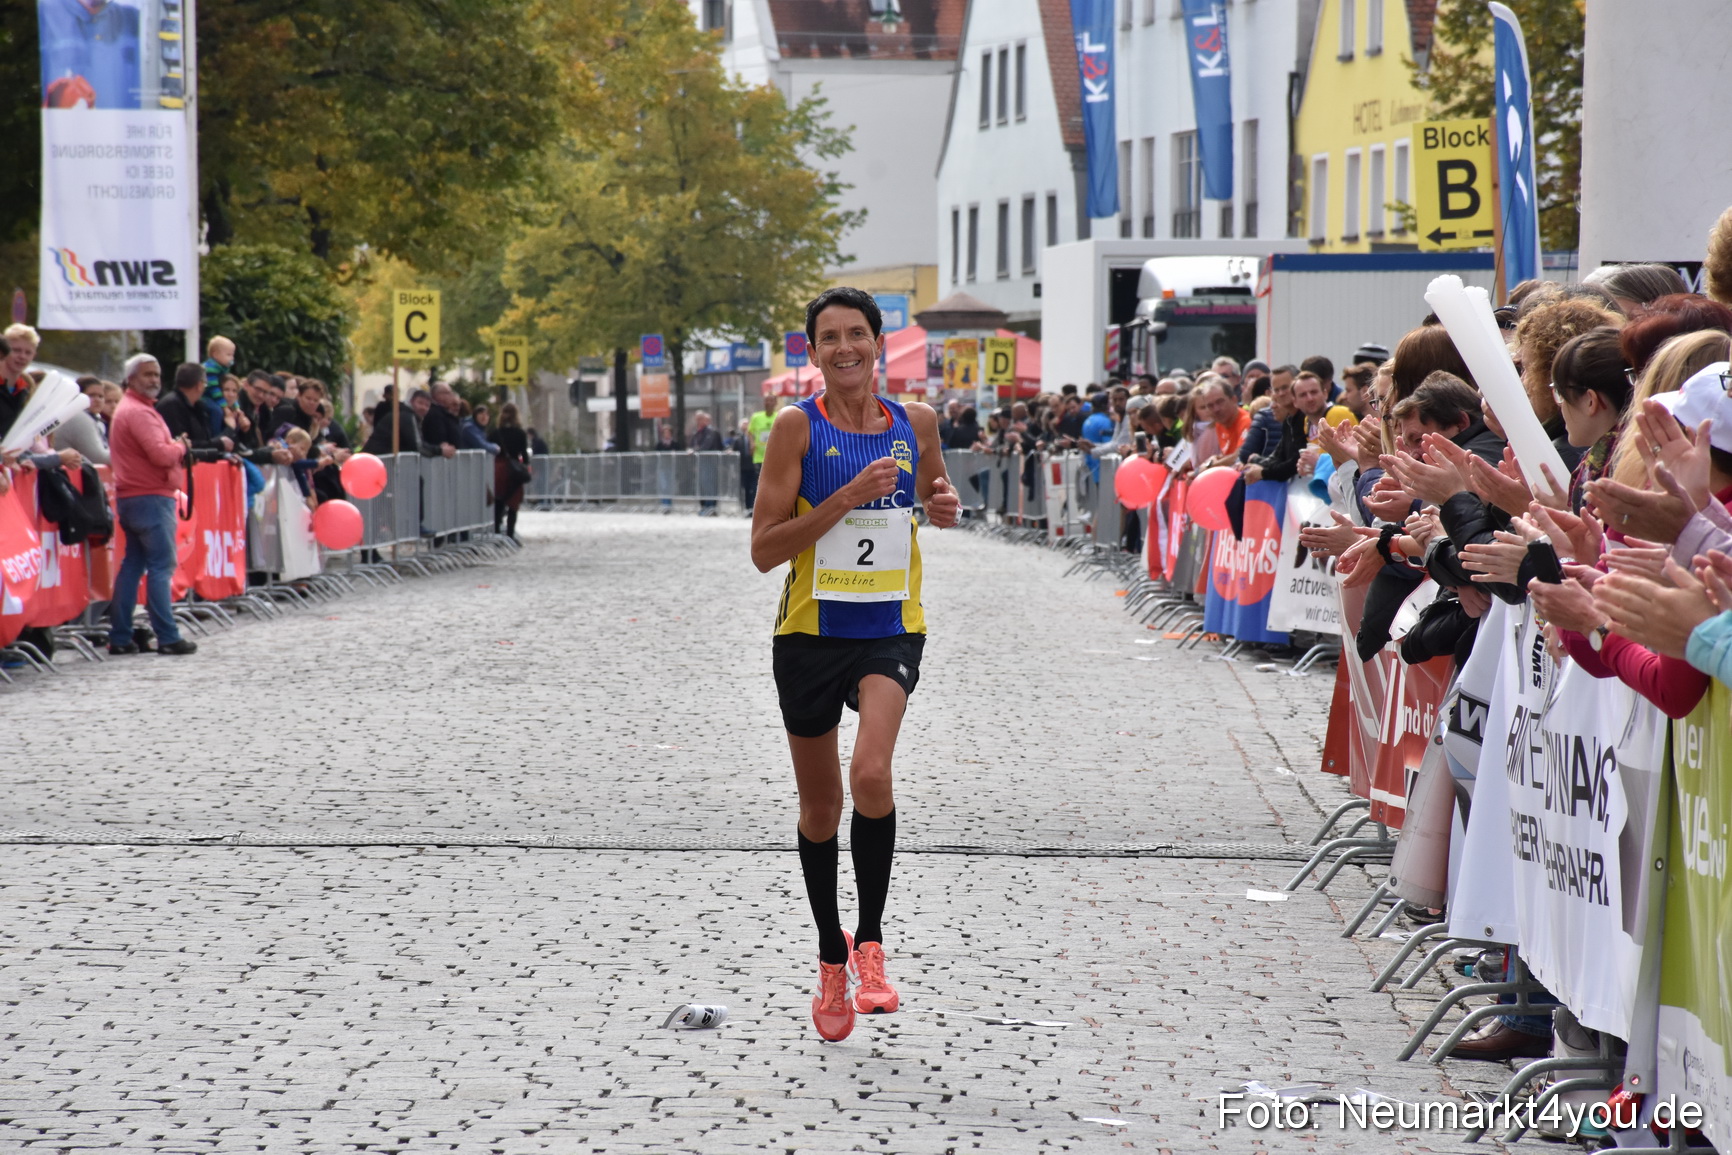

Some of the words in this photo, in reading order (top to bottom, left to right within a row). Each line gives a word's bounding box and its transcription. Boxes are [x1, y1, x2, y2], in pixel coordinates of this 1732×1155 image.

[1192, 3, 1224, 77] K&L
[1082, 32, 1109, 102] K&L
[1353, 99, 1382, 134] HOTEL
[1423, 124, 1490, 150] Block
[1437, 159, 1481, 220] B
[400, 293, 435, 305] Block
[405, 310, 428, 343] C
[503, 350, 520, 373] D
[993, 352, 1009, 375] D
[855, 518, 888, 526] BOCK
[857, 539, 874, 565] 2
[819, 573, 875, 586] Christine
[1305, 606, 1321, 620] wir
[1532, 634, 1544, 689] swn
